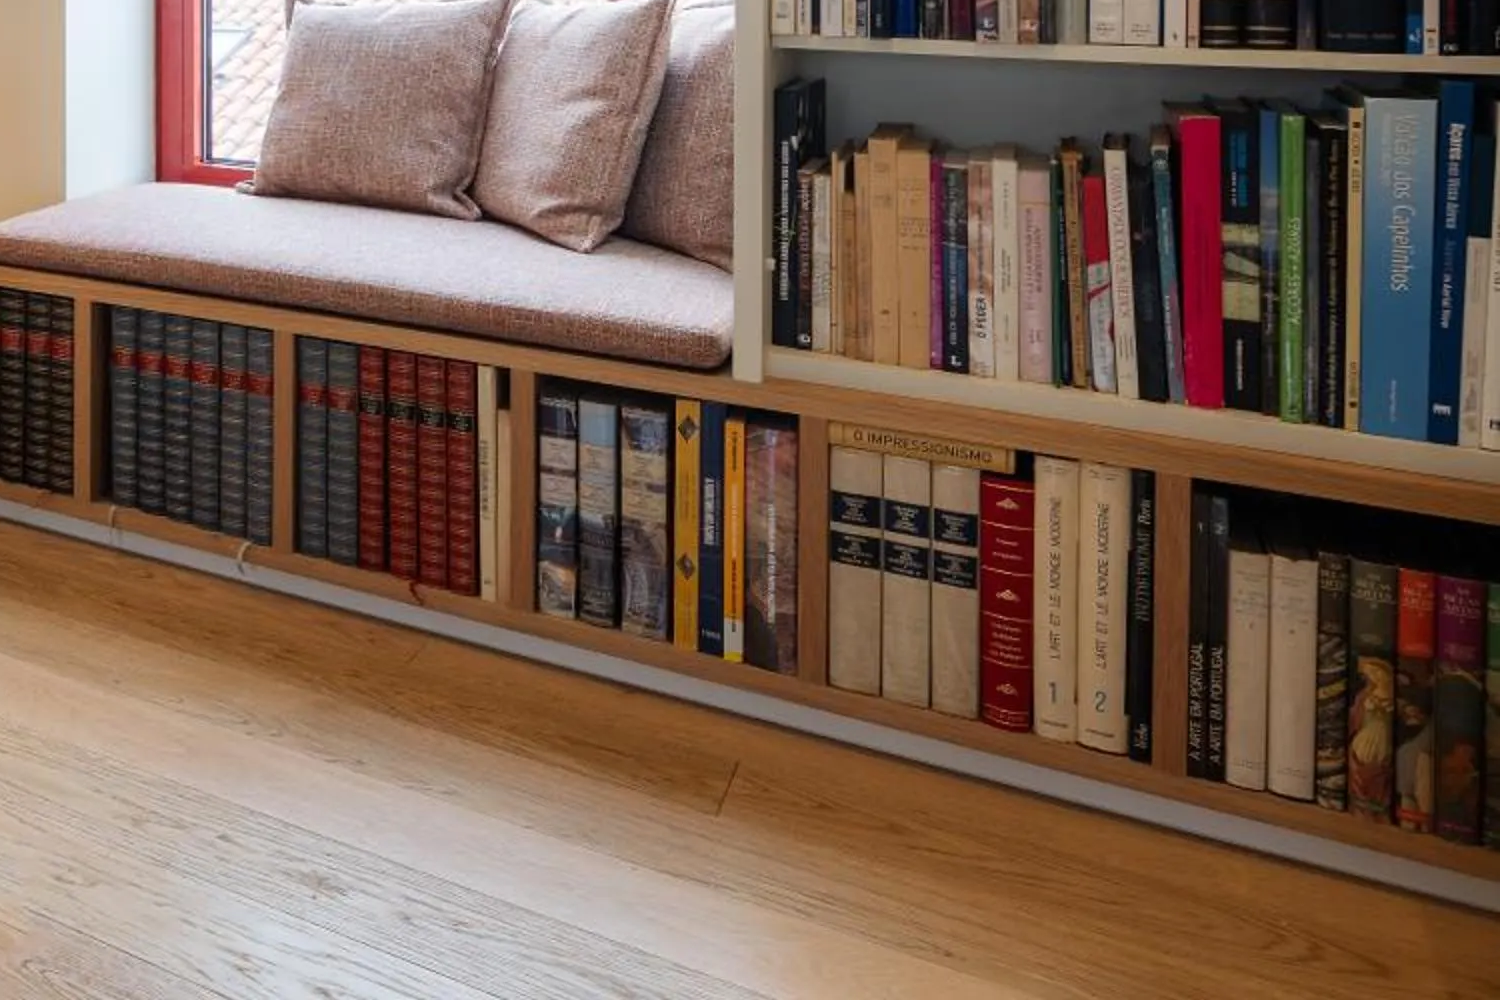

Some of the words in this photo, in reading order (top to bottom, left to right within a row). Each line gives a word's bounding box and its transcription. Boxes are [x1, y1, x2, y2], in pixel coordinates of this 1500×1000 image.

[1395, 113, 1420, 167] Vulcão
[1447, 123, 1466, 160] Açores
[1393, 171, 1415, 199] dos
[1387, 204, 1416, 292] Capelinhos
[853, 429, 863, 442] O
[866, 431, 994, 463] IMPRESSIONISMO
[1047, 495, 1061, 547] MODERNE
[1096, 503, 1110, 554] MODERNE
[1048, 551, 1062, 590] MONDE
[1096, 558, 1109, 597] MONDE
[1048, 593, 1061, 608] LE
[1095, 601, 1108, 615] LE
[1048, 613, 1061, 627] ET
[1095, 620, 1108, 635] ET
[1191, 642, 1204, 698] PORTUGAL
[1211, 645, 1224, 701] PORTUGAL
[1094, 690, 1108, 713] 2
[1190, 700, 1202, 717] EM
[1211, 702, 1223, 721] EM
[1190, 719, 1202, 748] ARTE
[1210, 727, 1222, 750] ARTE
[1190, 751, 1202, 760] A
[1210, 753, 1222, 763] A
